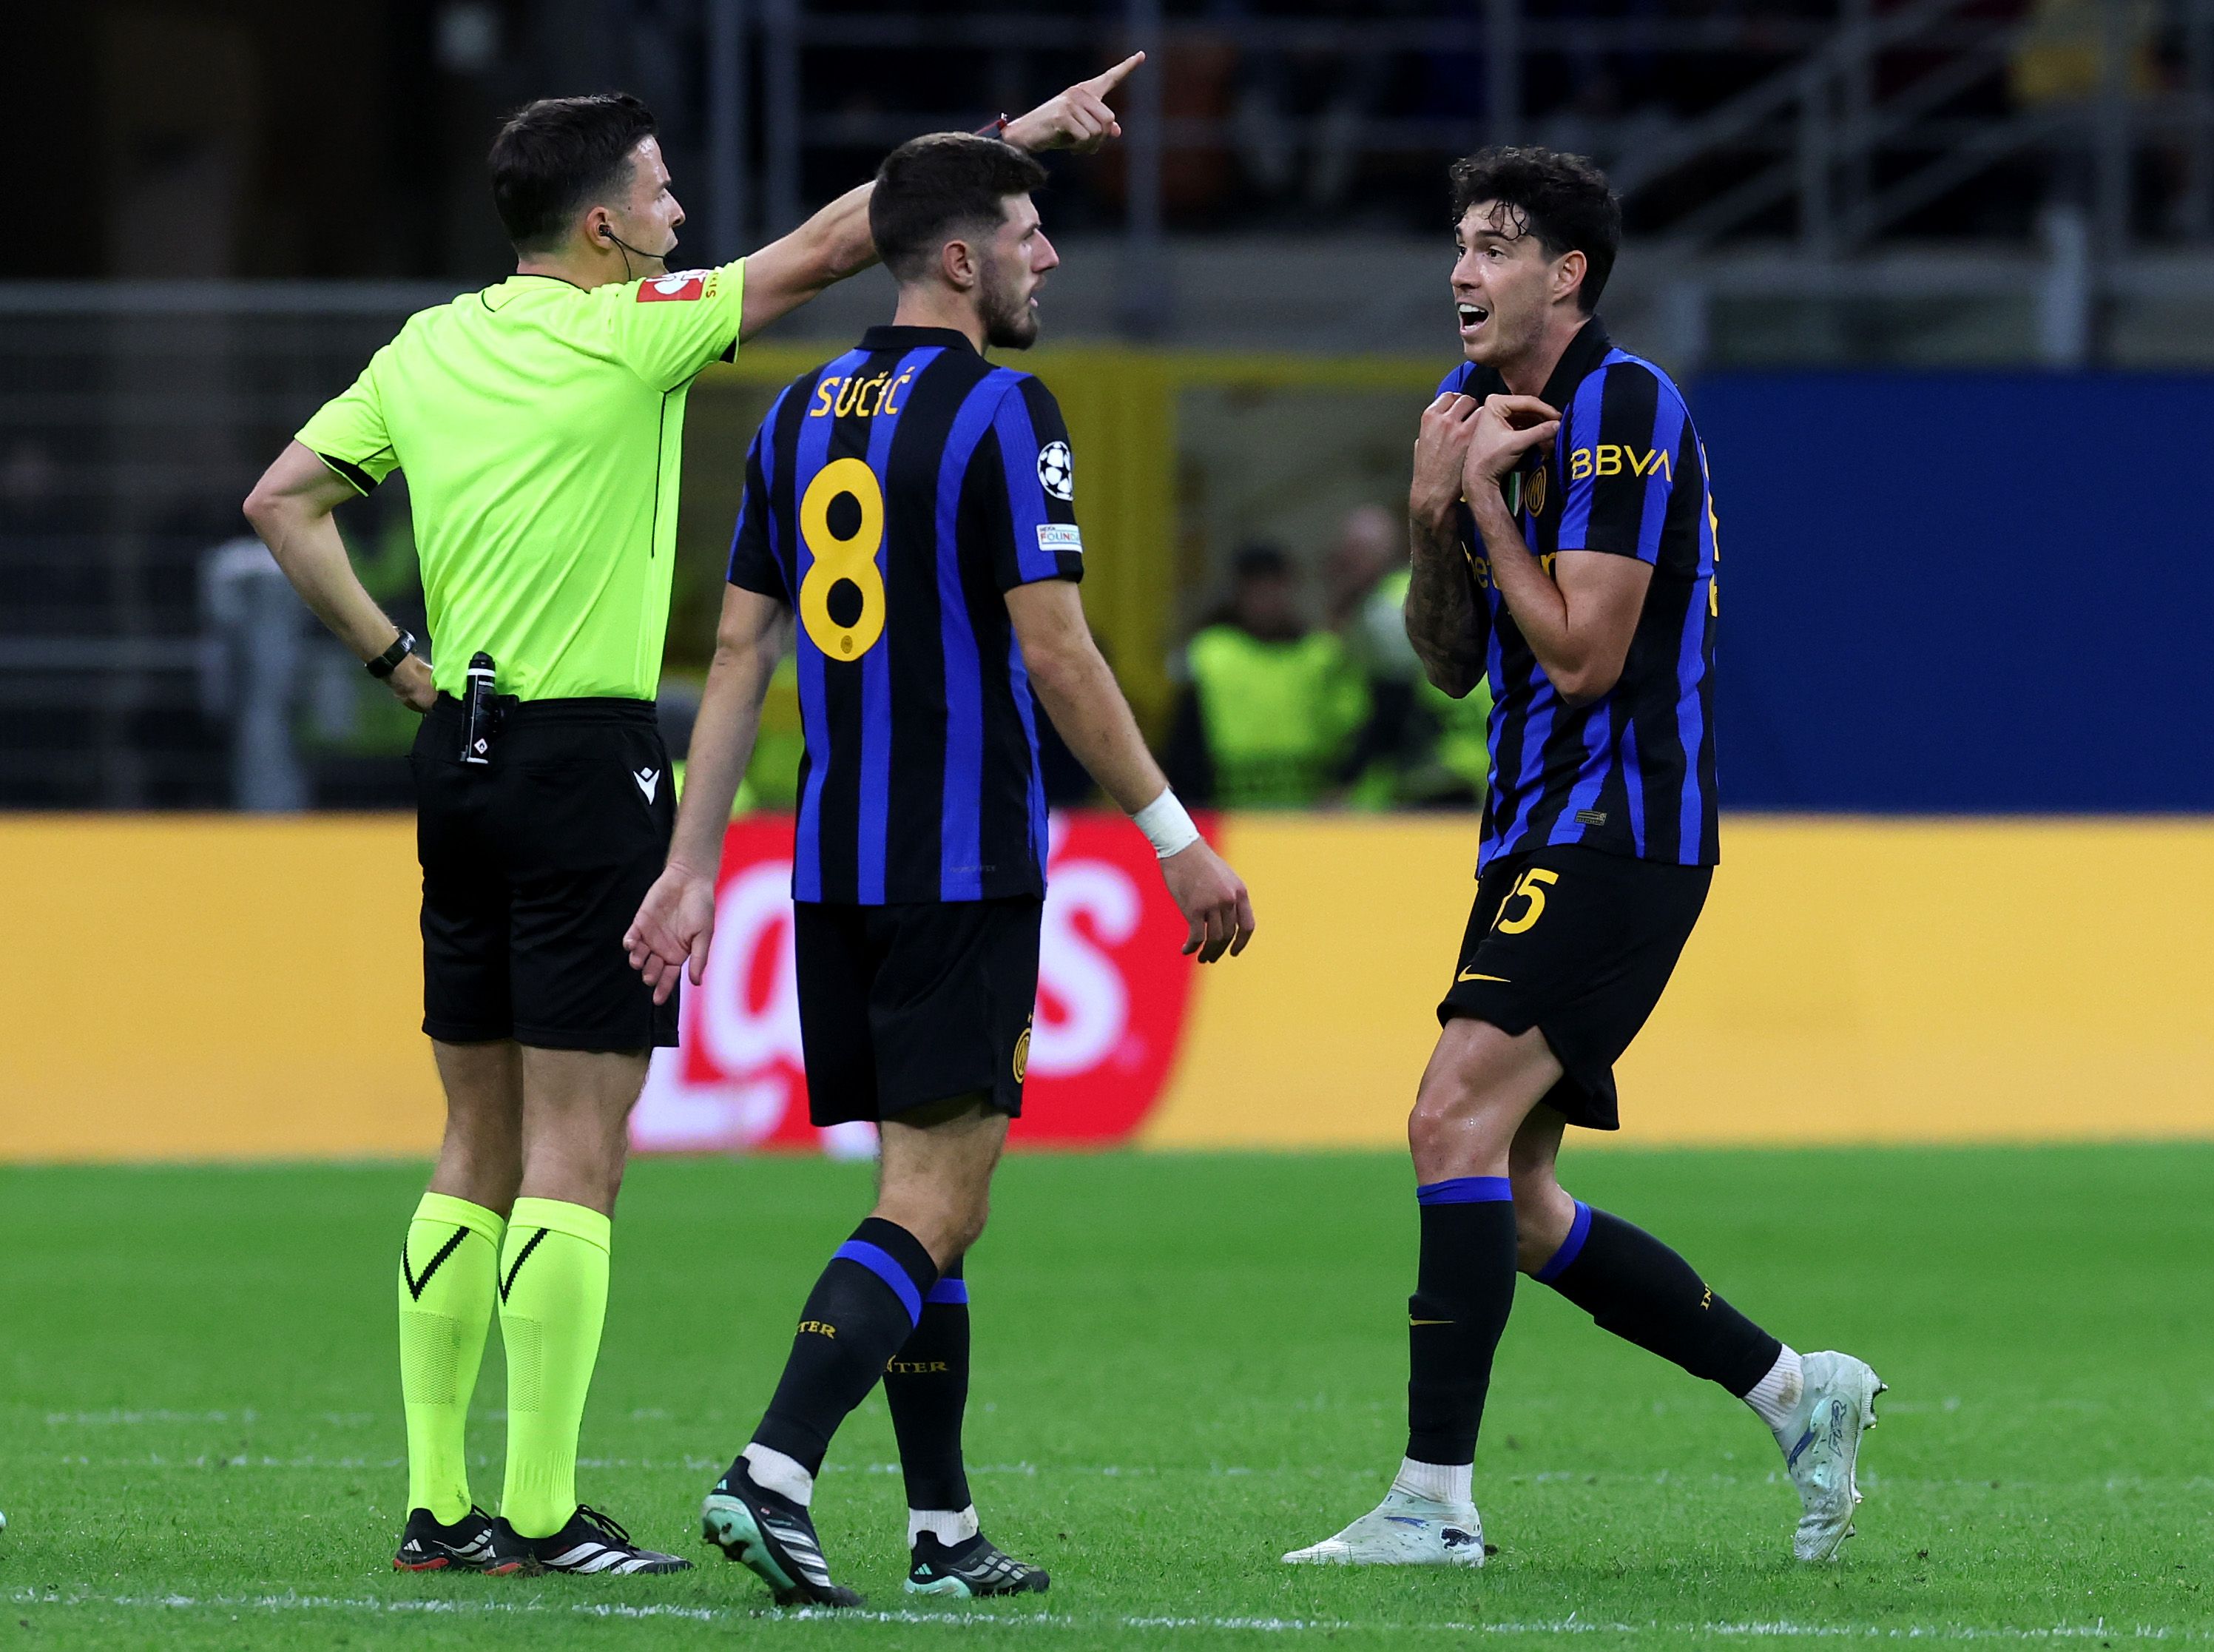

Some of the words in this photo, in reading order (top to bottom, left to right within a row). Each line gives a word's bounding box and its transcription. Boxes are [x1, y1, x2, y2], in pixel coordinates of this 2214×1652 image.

[810, 366, 916, 418] SUČIĆ
[1570, 445, 1672, 482] BBVA
[799, 456, 886, 662] 8
[1040, 532, 1079, 542] FOUND
[1490, 868, 1559, 934] 5
[797, 1320, 837, 1339] TER
